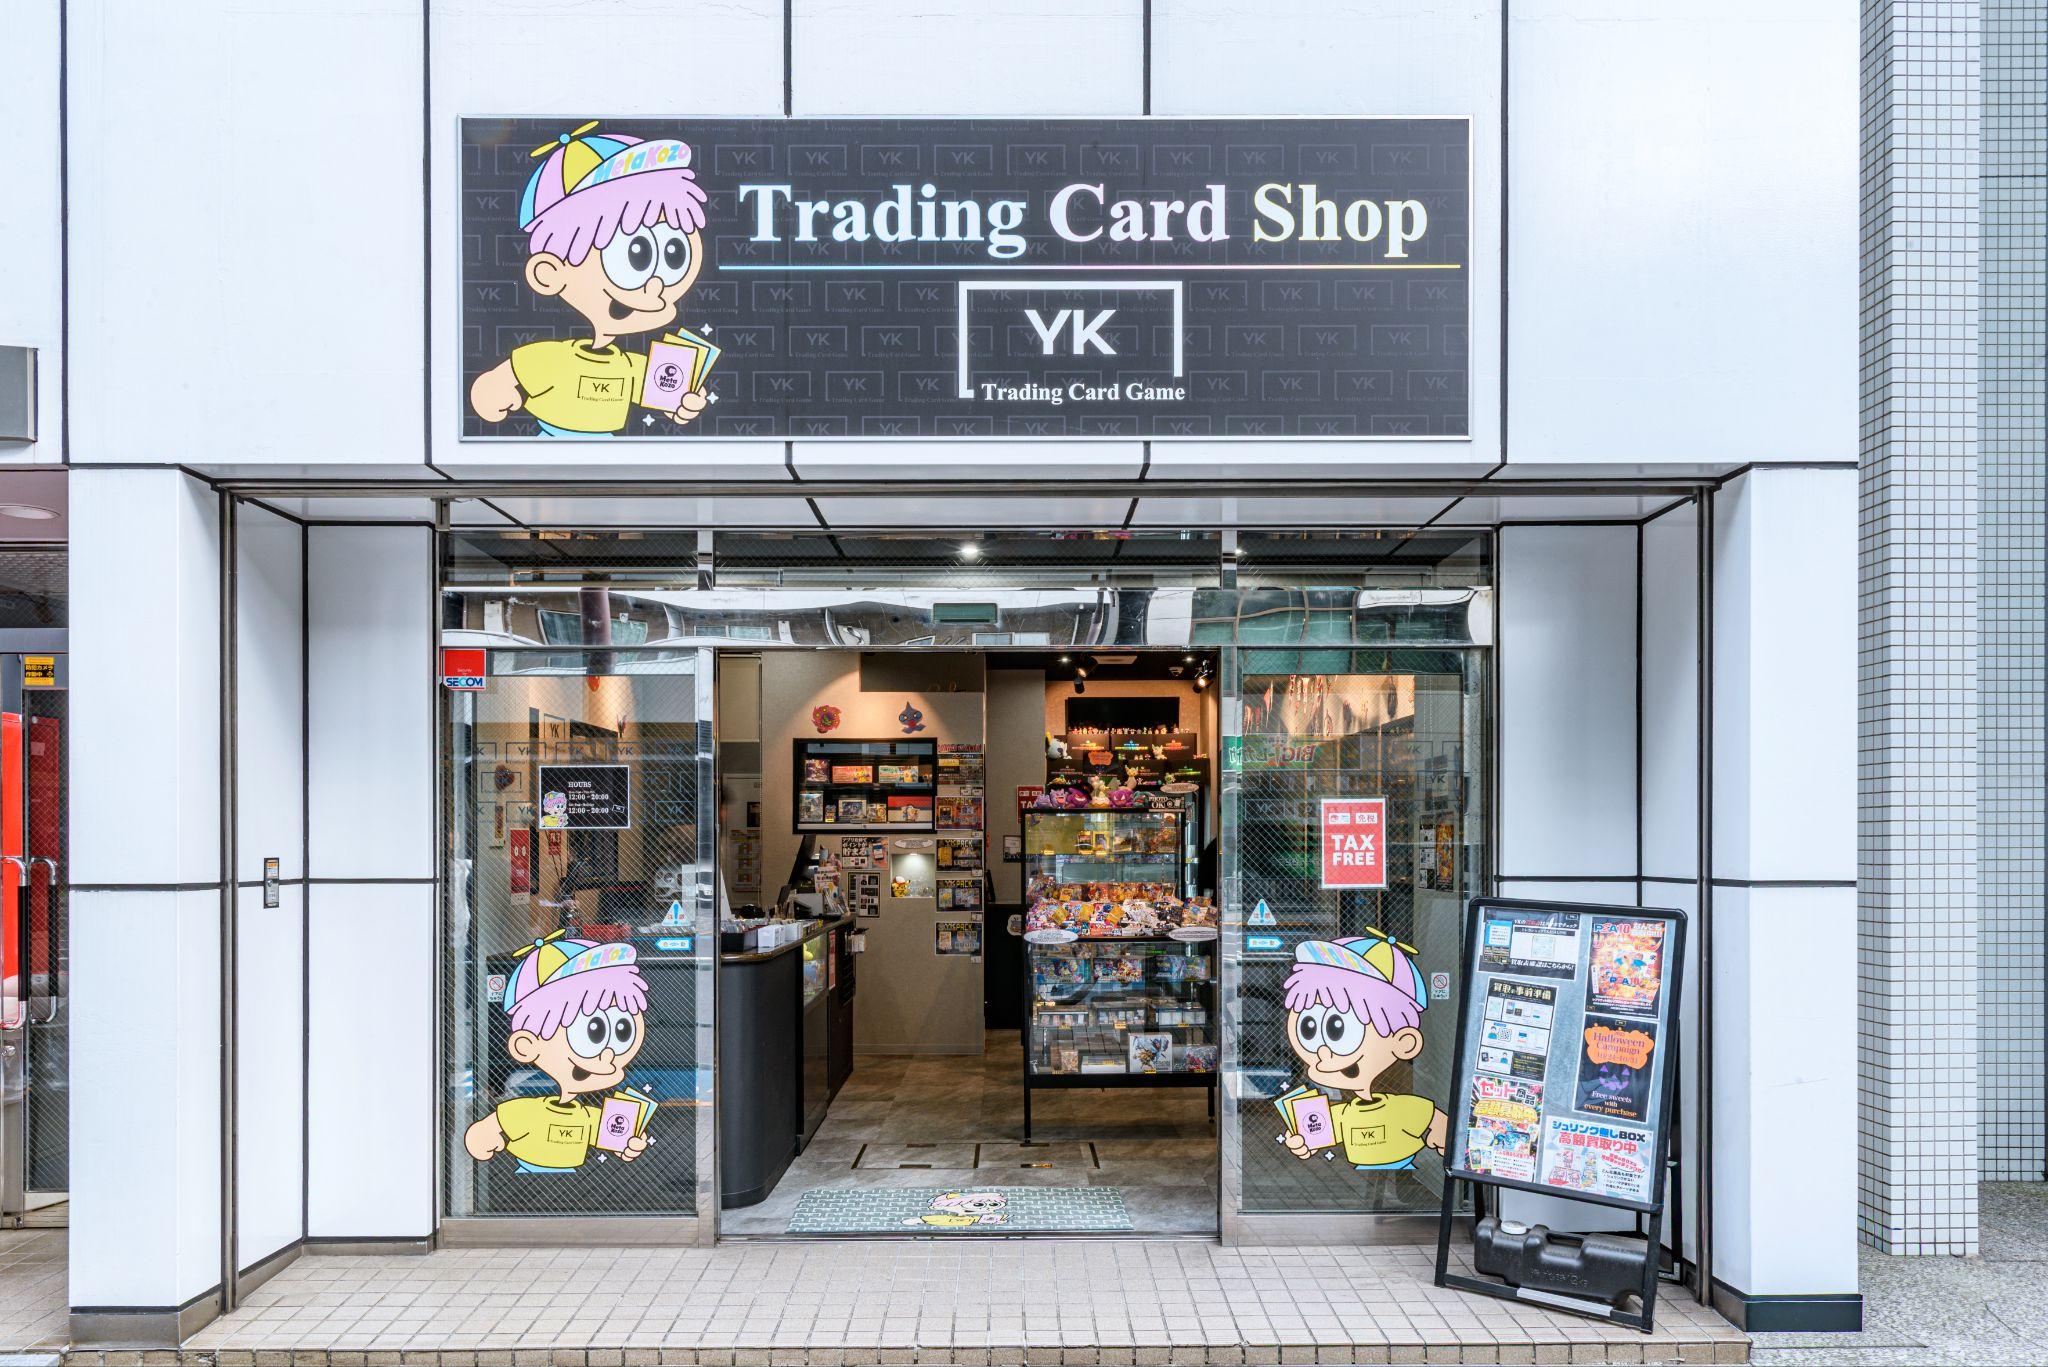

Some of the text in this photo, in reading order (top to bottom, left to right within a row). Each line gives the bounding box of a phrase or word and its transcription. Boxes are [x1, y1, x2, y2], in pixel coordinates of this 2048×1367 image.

[732, 152, 756, 165] YK
[805, 152, 829, 165] YK
[878, 152, 902, 165] YK
[951, 152, 975, 165] YK
[1024, 152, 1048, 165] YK
[1097, 152, 1121, 165] YK
[1170, 152, 1194, 165] YK
[1242, 152, 1266, 165] YK
[1315, 152, 1339, 165] YK
[1388, 150, 1412, 164] YK
[592, 144, 690, 186] MetaKozo
[476, 196, 500, 210] YK
[739, 182, 1428, 258] Trading Card Shop
[732, 242, 756, 256] YK
[476, 288, 500, 301] YK
[696, 288, 720, 301] YK
[769, 288, 793, 301] YK
[842, 288, 866, 301] YK
[915, 288, 939, 301] YK
[1206, 288, 1230, 301] YK
[1279, 288, 1303, 301] YK
[1351, 286, 1375, 300] YK
[1424, 286, 1448, 300] YK
[1025, 309, 1117, 355] YK
[1315, 332, 1339, 345] YK
[1388, 332, 1412, 345] YK
[733, 332, 757, 346] YK
[806, 332, 830, 346] YK
[878, 332, 902, 346] YK
[1242, 332, 1266, 346] YK
[592, 382, 610, 393] YK
[769, 378, 793, 391] YK
[842, 378, 866, 391] YK
[915, 378, 939, 391] YK
[1206, 378, 1230, 391] YK
[1279, 378, 1303, 391] YK
[1351, 376, 1375, 390] YK
[1424, 376, 1448, 390] YK
[981, 383, 1186, 406] Trading Card Game
[446, 677, 483, 687] SECOM
[1358, 814, 1376, 823] 免税
[1330, 834, 1375, 851] TAX
[1332, 852, 1376, 866] FREE
[1593, 1032, 1645, 1048] Halloween
[1596, 1042, 1640, 1055] Campaign
[1591, 1090, 1632, 1103] Free sweets
[1584, 1103, 1637, 1118] every purchase
[1604, 1100, 1618, 1108] with
[559, 1129, 573, 1138] YK
[1361, 1130, 1375, 1139] YK
[1552, 1121, 1646, 1142] シュリンク無しBOX
[1558, 1131, 1638, 1155] 高額買取り中
